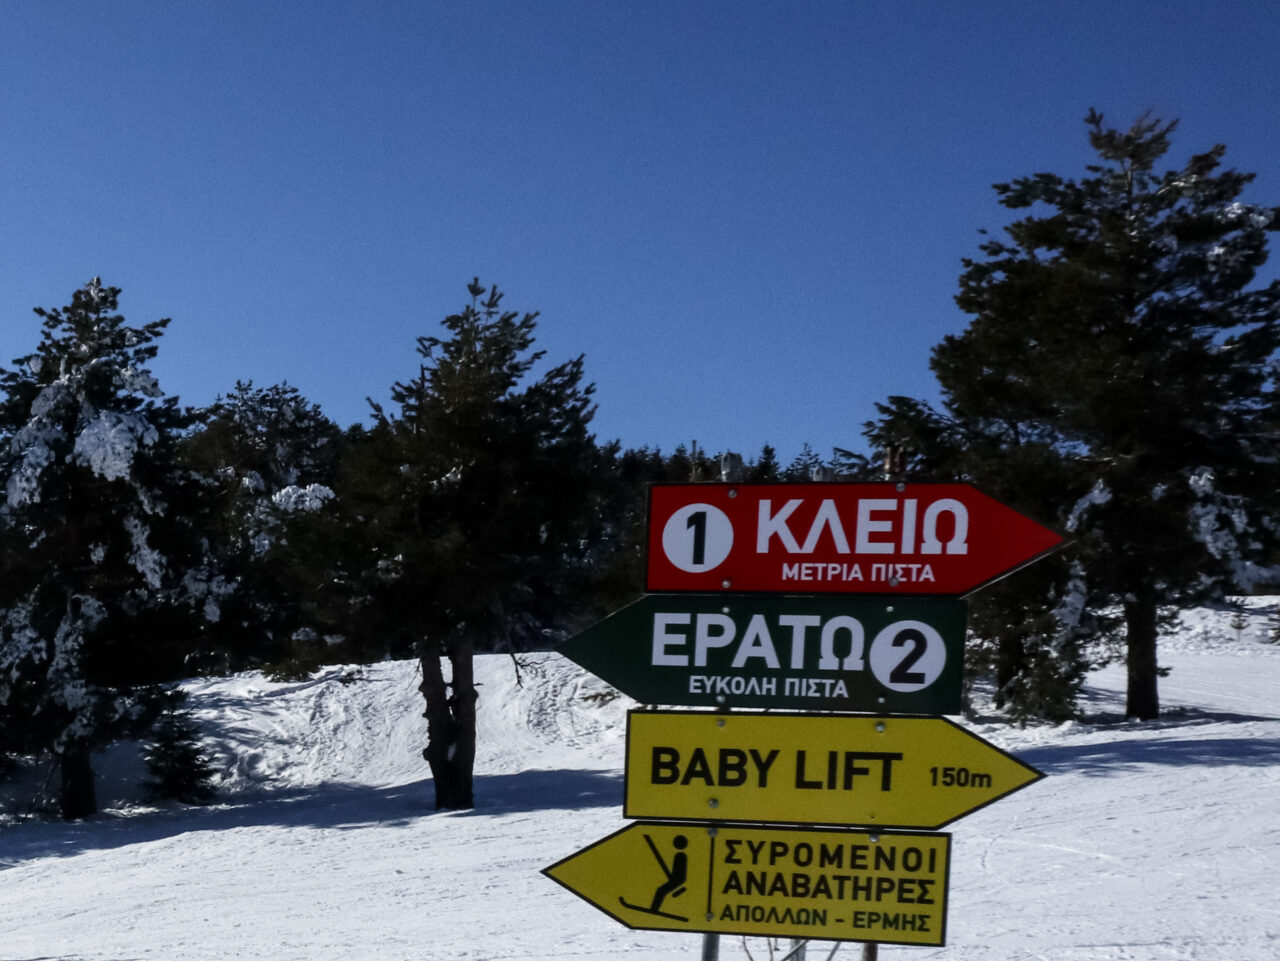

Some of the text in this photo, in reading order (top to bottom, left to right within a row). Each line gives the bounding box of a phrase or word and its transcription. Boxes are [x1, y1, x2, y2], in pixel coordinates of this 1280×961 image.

[686, 498, 969, 565] 1 ΚΛΕΙΩ
[781, 563, 936, 583] ΜΕΤΡΙΑ ΠΙΣΤΑ
[651, 612, 928, 684] ΕΡΑΤΩ 2
[689, 675, 849, 698] ΕΥΚΟΛΗ ΠΙΣΤΑ
[650, 746, 993, 792] BABY LIFT 150m
[724, 839, 937, 873] ΣΥΡΟΜΕΝΟΙ
[722, 870, 936, 905] ΑΝΑΒΑΤΗΡΕΣ
[720, 904, 828, 926] ΑΠΟΛΛΩΝ
[852, 910, 931, 932] ΕΡΜΗΣ
